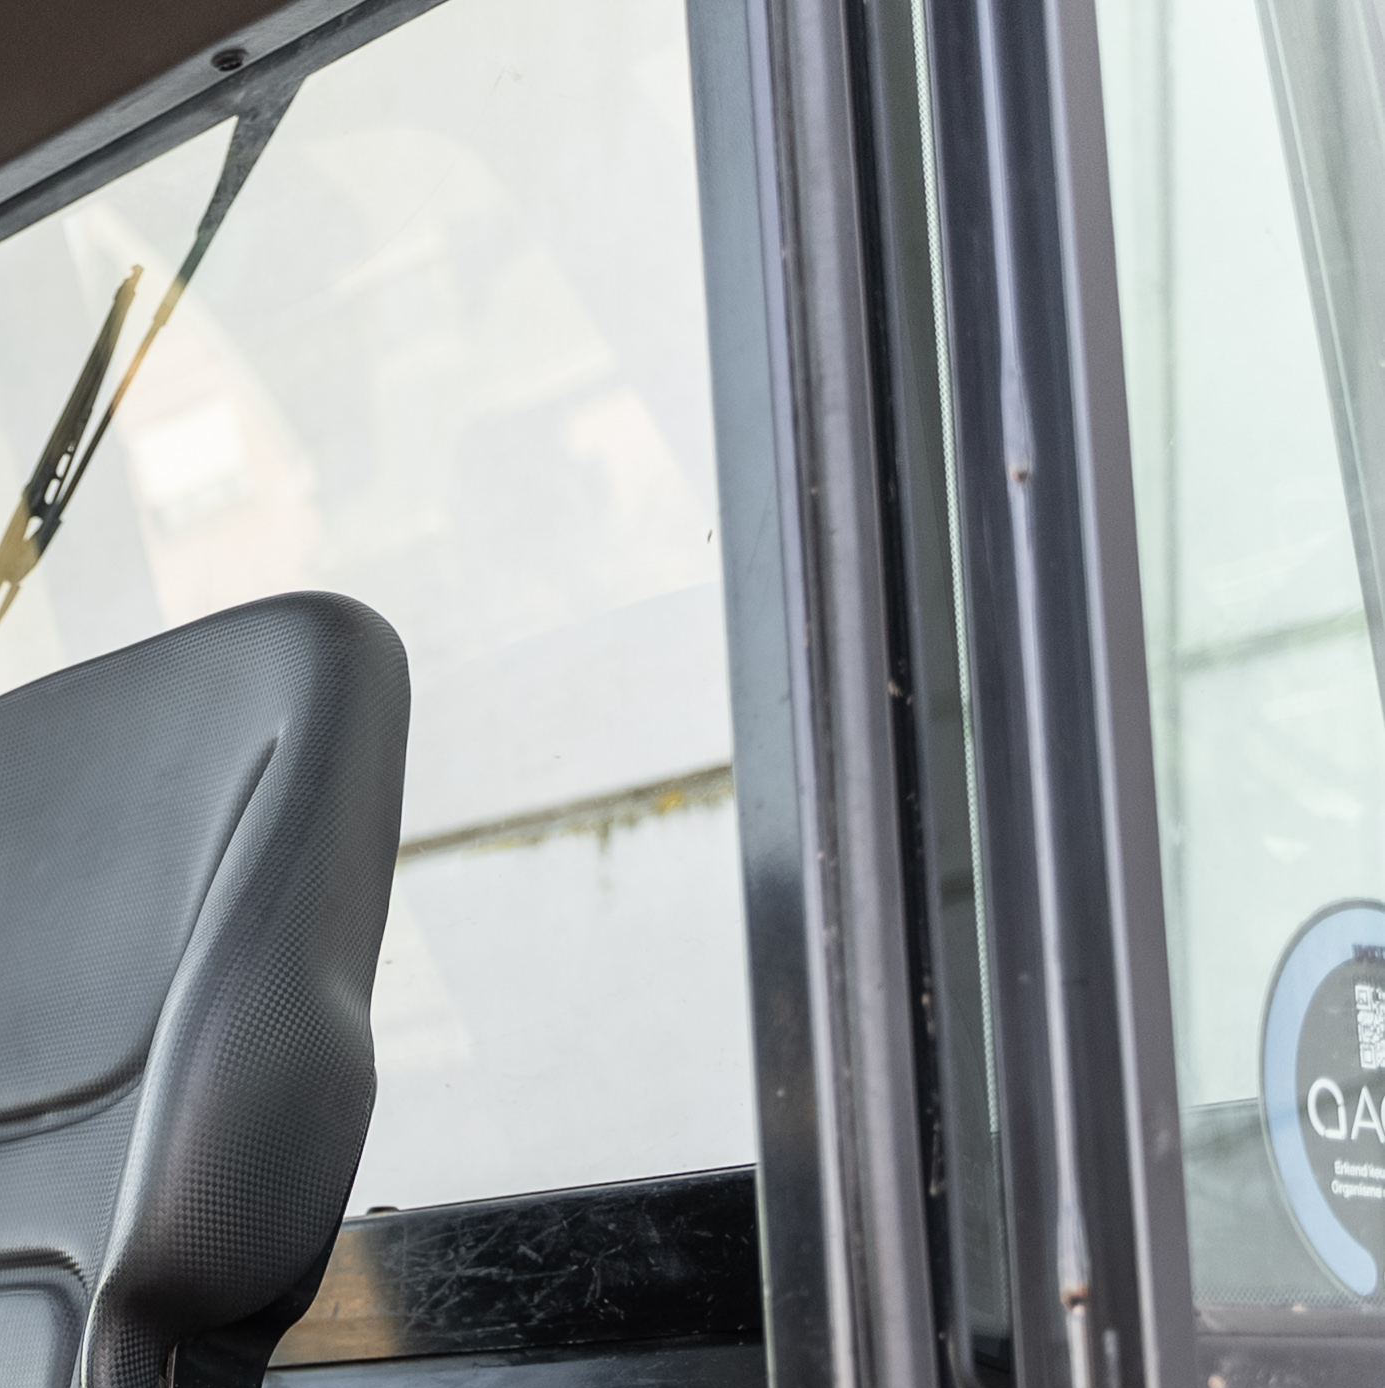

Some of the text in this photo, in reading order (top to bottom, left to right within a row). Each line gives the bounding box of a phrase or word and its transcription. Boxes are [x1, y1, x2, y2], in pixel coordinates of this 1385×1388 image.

[1307, 1077, 1385, 1143] QA
[1334, 1159, 1368, 1177] Erkend
[1331, 1179, 1382, 1198] Organisme
